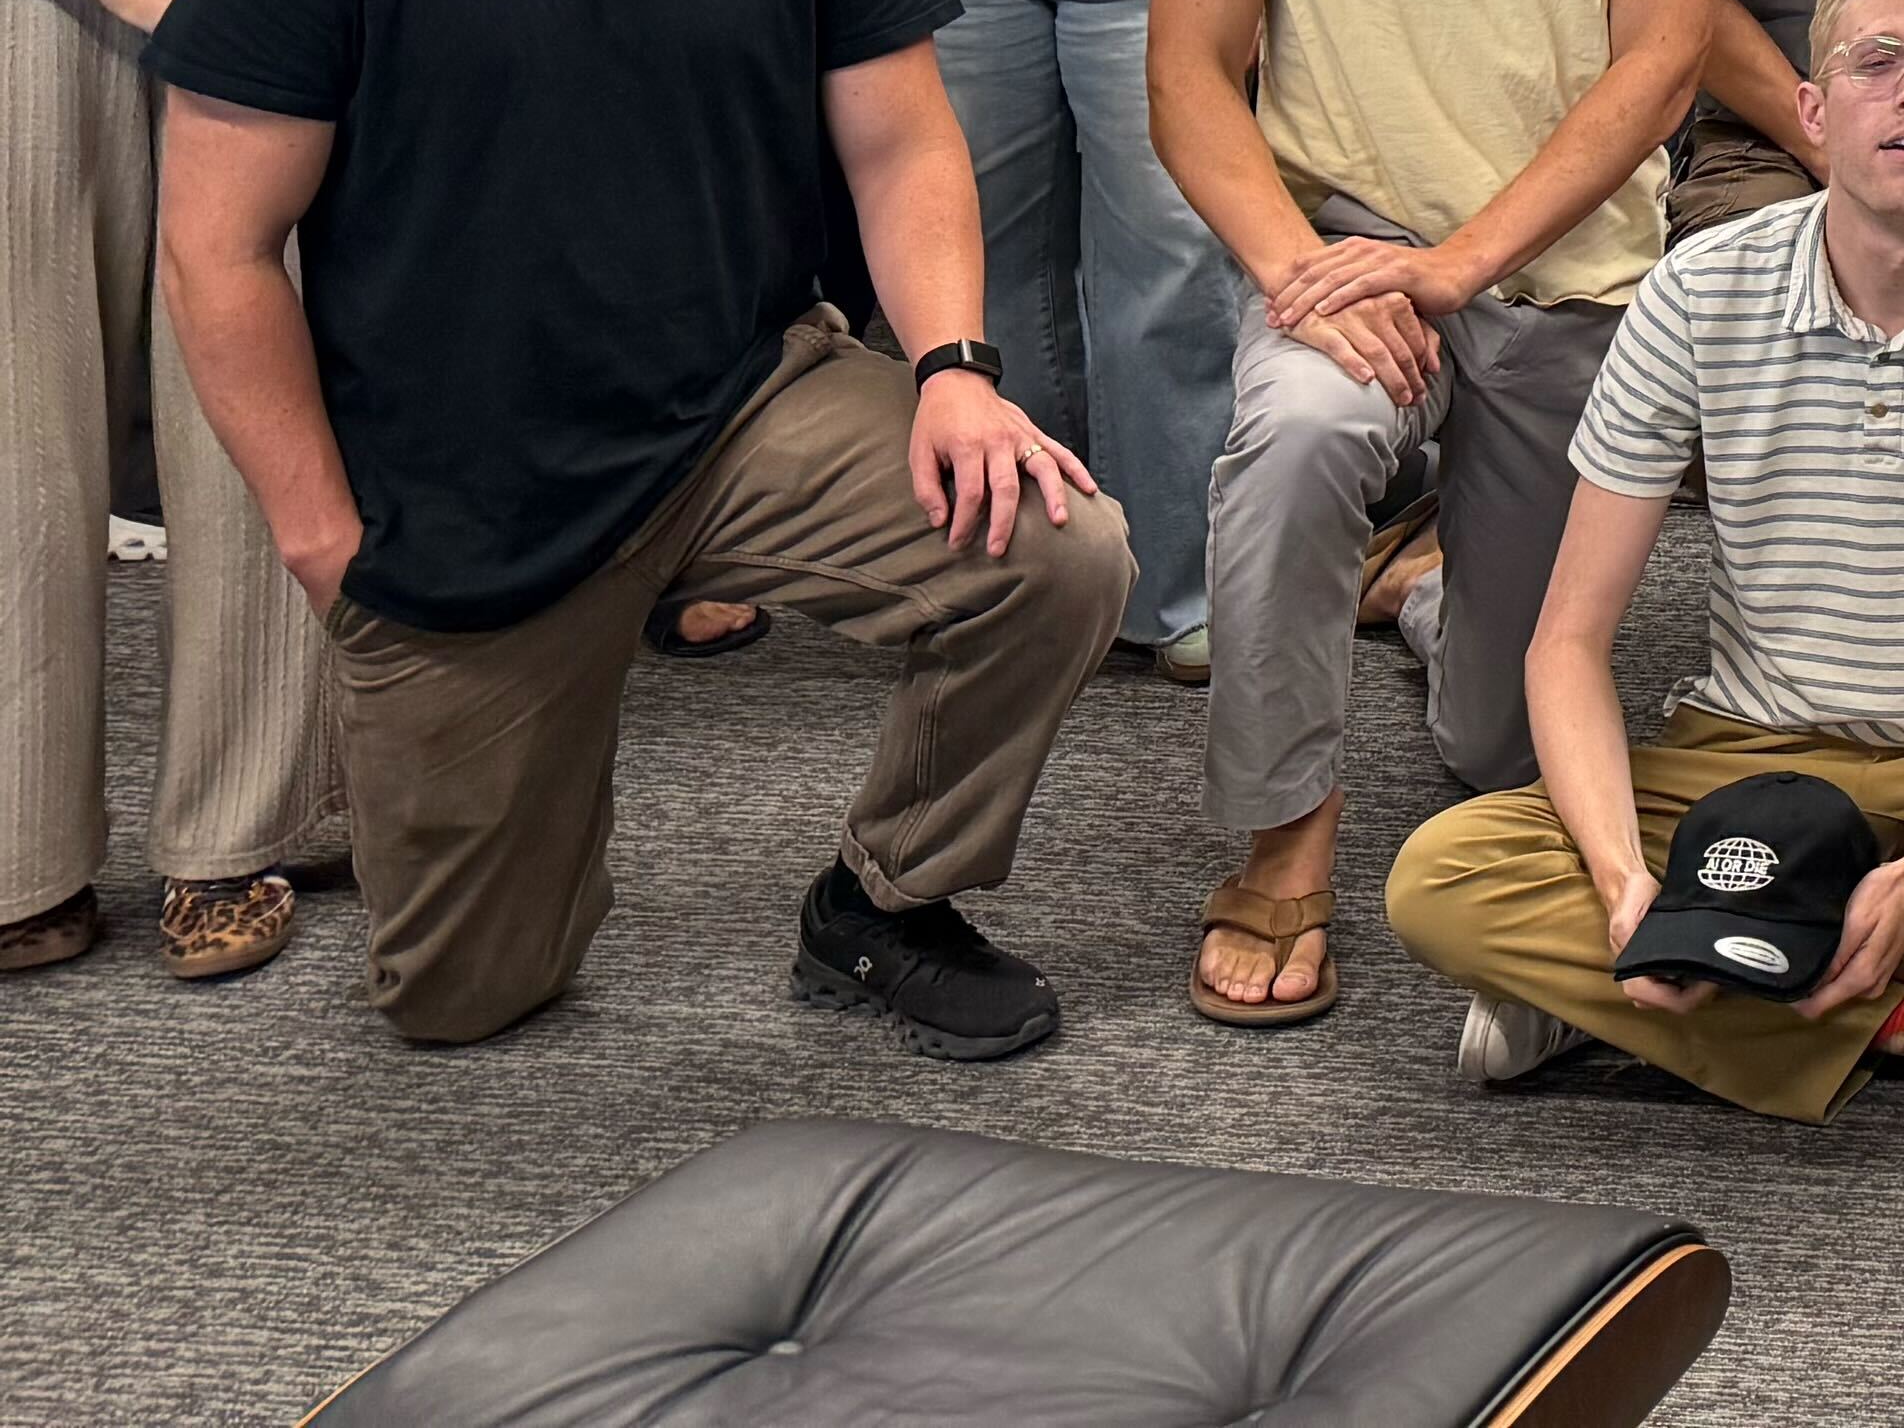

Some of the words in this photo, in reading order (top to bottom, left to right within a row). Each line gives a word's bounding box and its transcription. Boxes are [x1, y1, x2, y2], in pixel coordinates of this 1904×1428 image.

[1706, 857, 1721, 870] AI
[1722, 858, 1742, 873] OR
[1744, 859, 1770, 876] DIE
